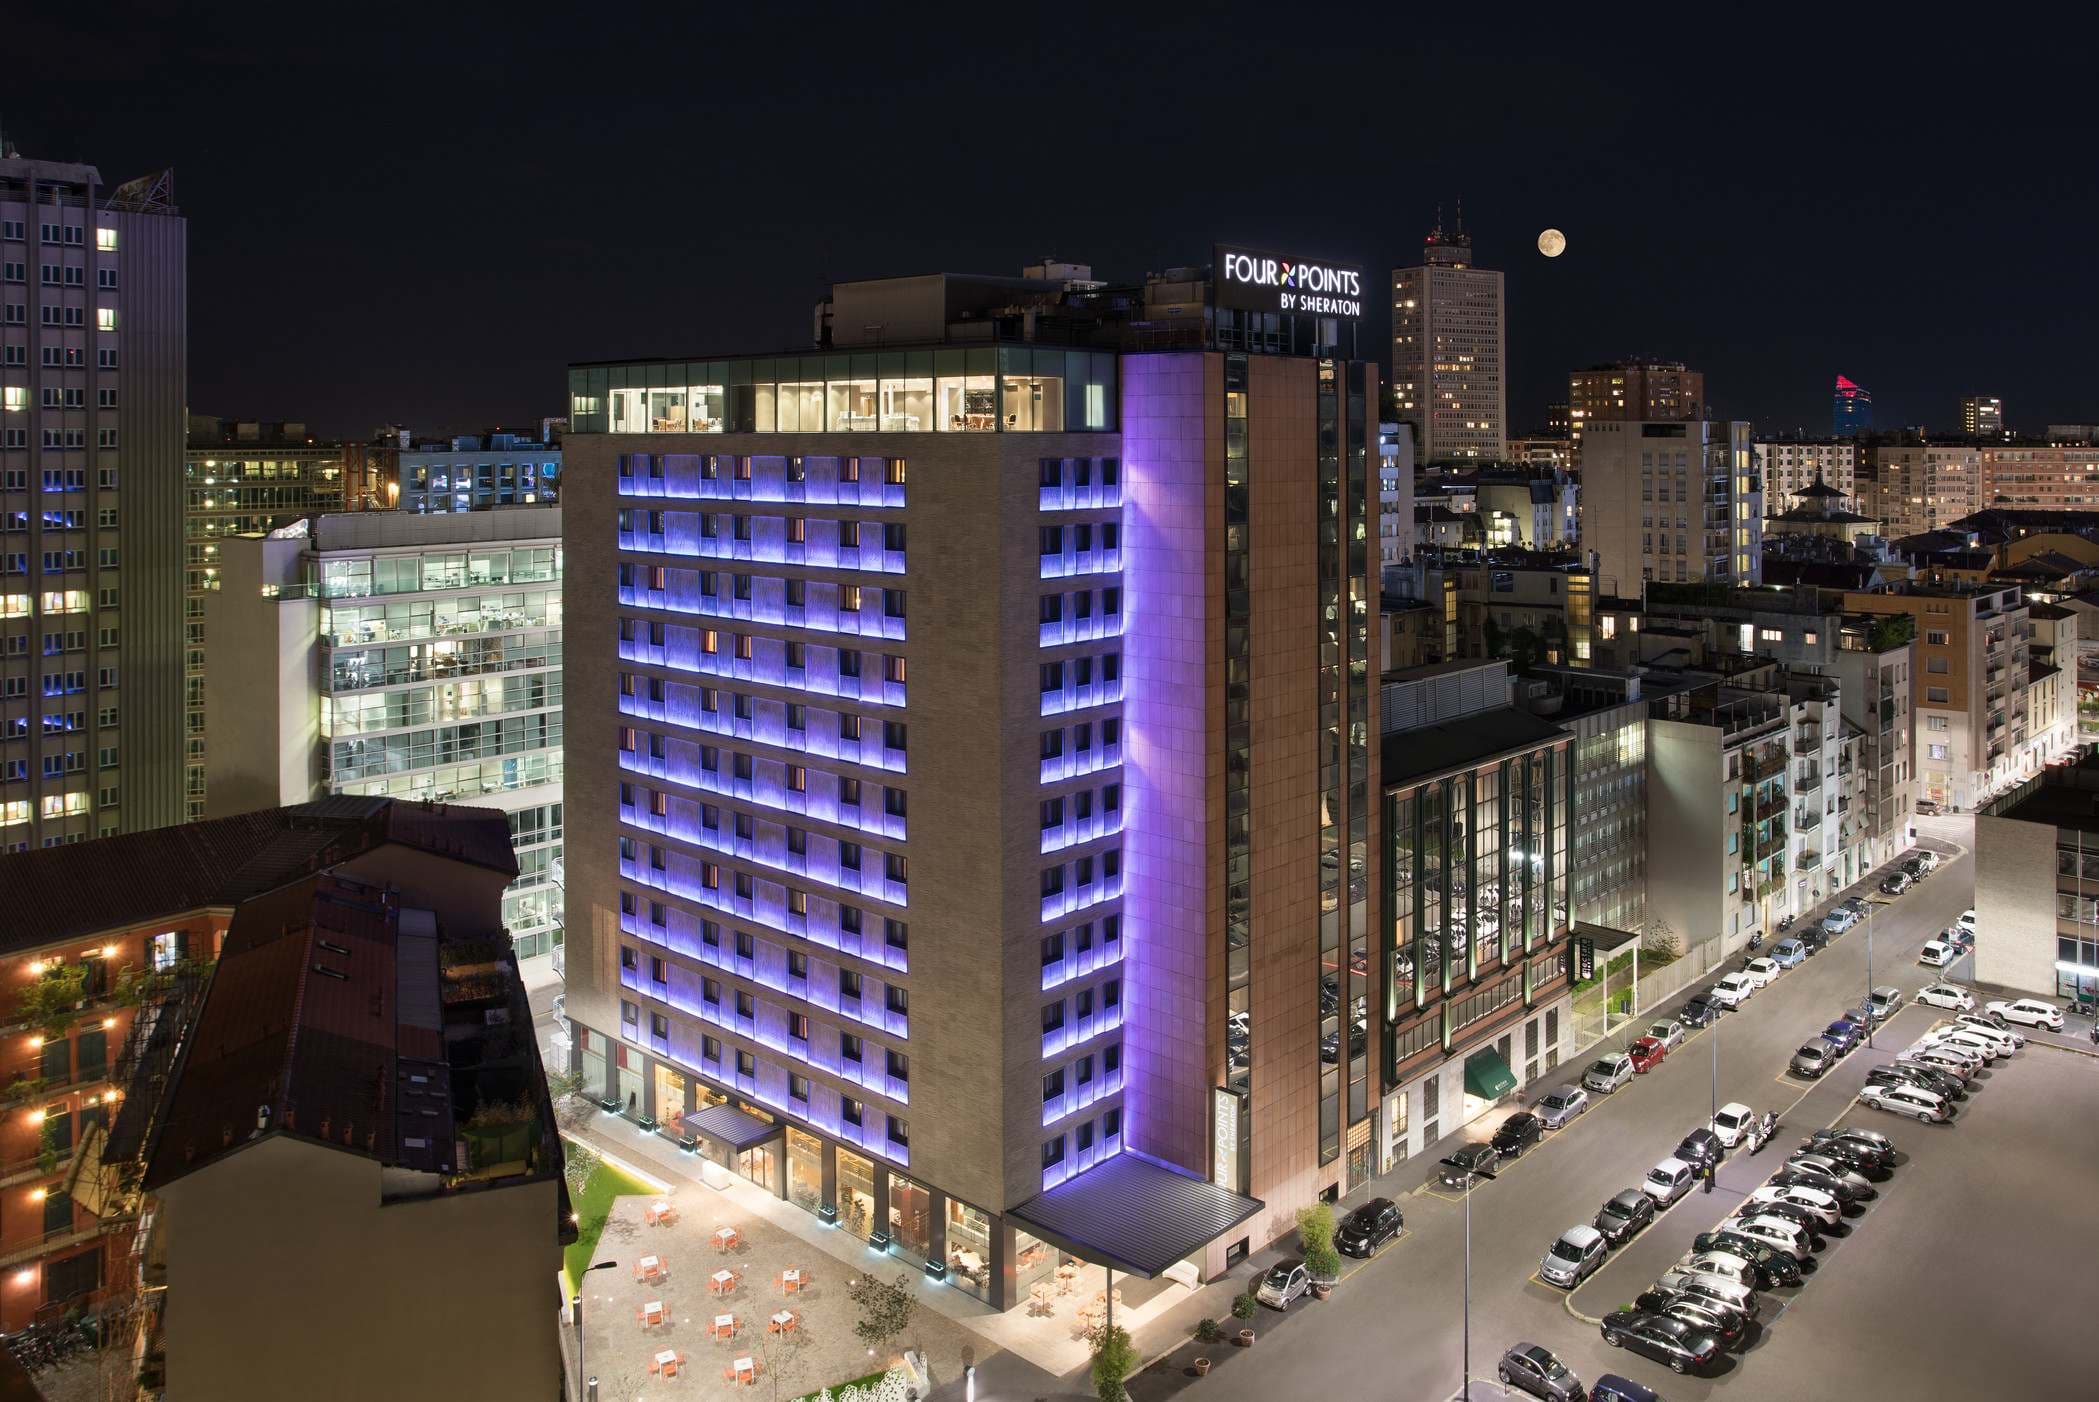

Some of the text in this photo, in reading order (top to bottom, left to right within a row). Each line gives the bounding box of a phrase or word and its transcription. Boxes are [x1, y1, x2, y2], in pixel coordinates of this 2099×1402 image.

[1225, 253, 1360, 296] FOUR POINTS
[1281, 293, 1360, 316] BY SHERATON
[1217, 1095, 1229, 1150] POINTS
